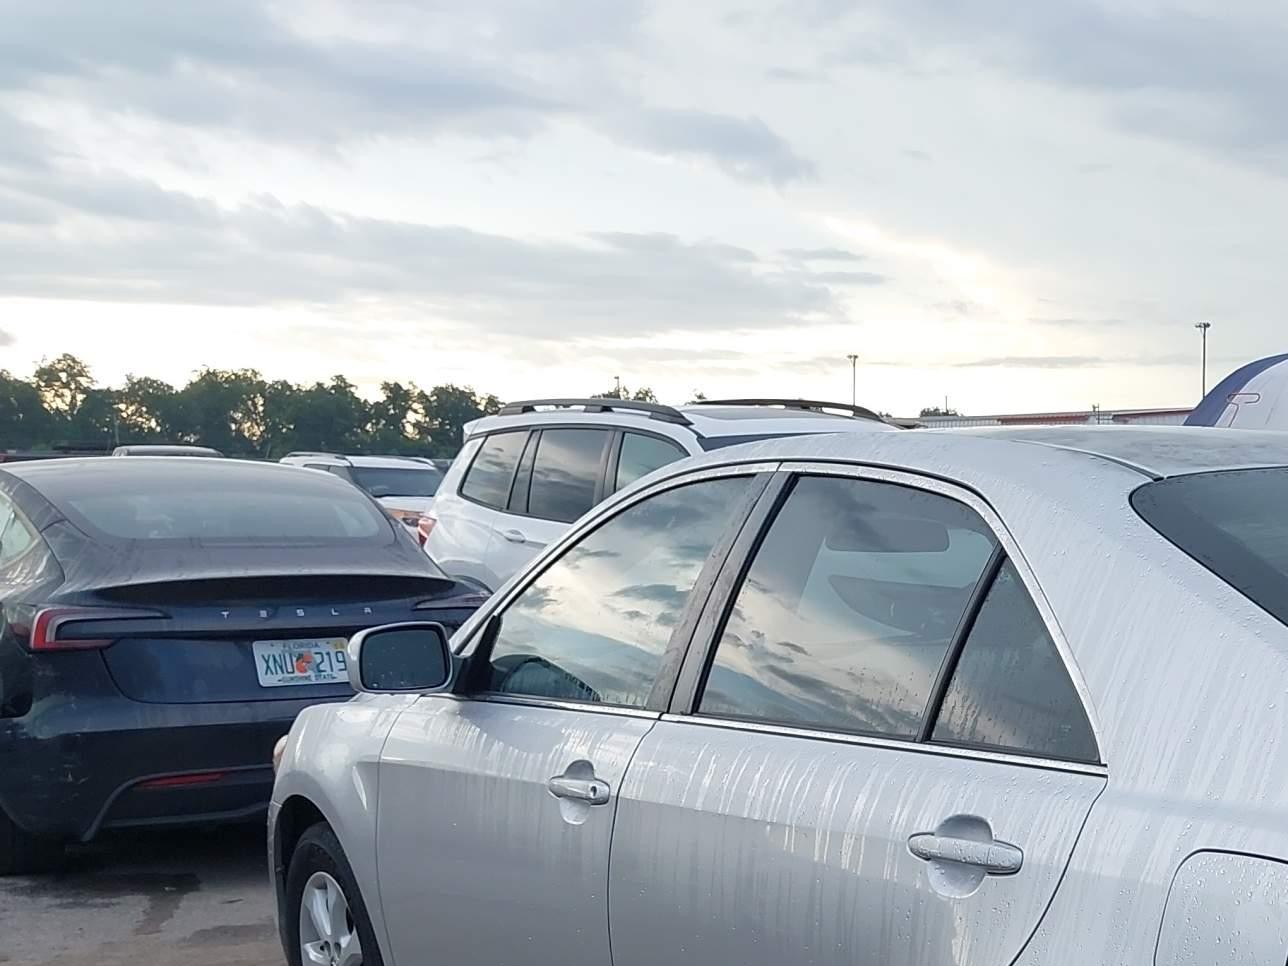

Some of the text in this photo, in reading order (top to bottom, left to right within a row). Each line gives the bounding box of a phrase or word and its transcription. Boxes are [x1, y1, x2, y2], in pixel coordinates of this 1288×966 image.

[221, 607, 372, 619] TESLA
[261, 650, 347, 676] XNU 219
